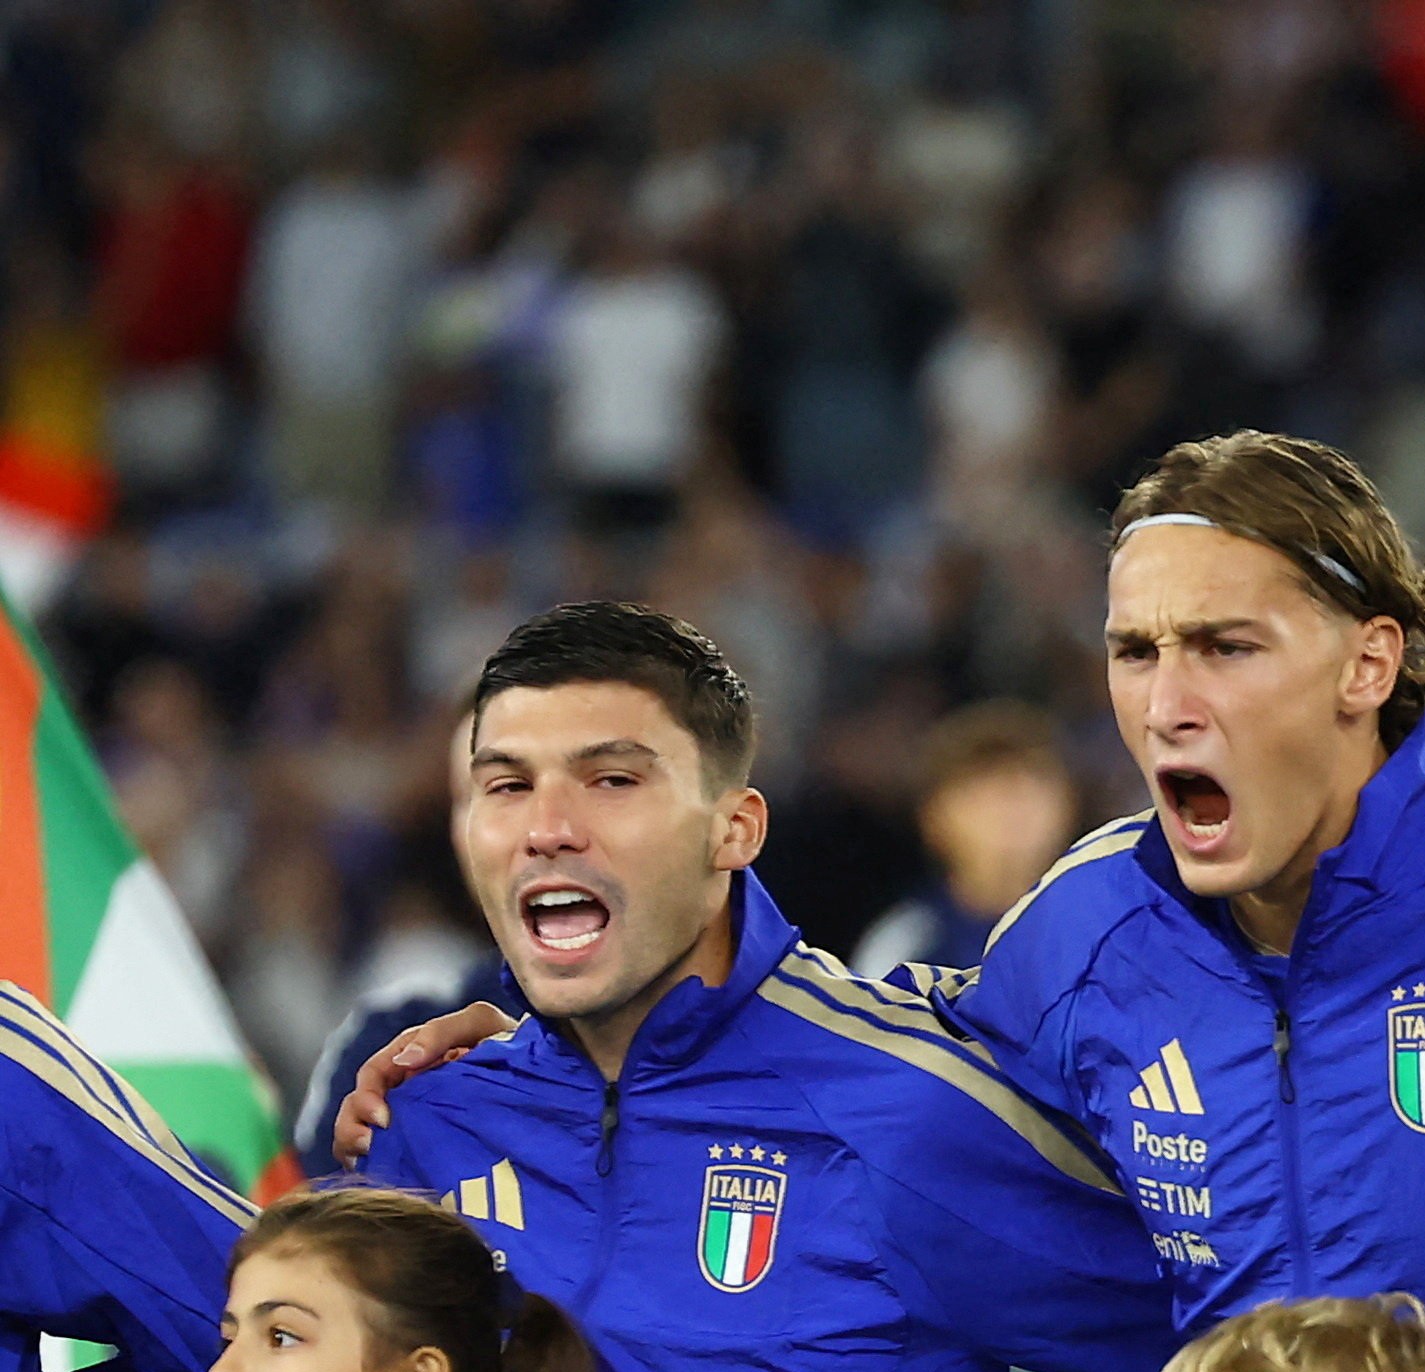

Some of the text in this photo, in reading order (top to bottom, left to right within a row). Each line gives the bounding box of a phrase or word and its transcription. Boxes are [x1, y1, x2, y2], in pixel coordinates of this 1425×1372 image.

[1133, 1120, 1207, 1163] Poste
[711, 1175, 776, 1204] ITALIA
[1160, 1182, 1211, 1219] TIM
